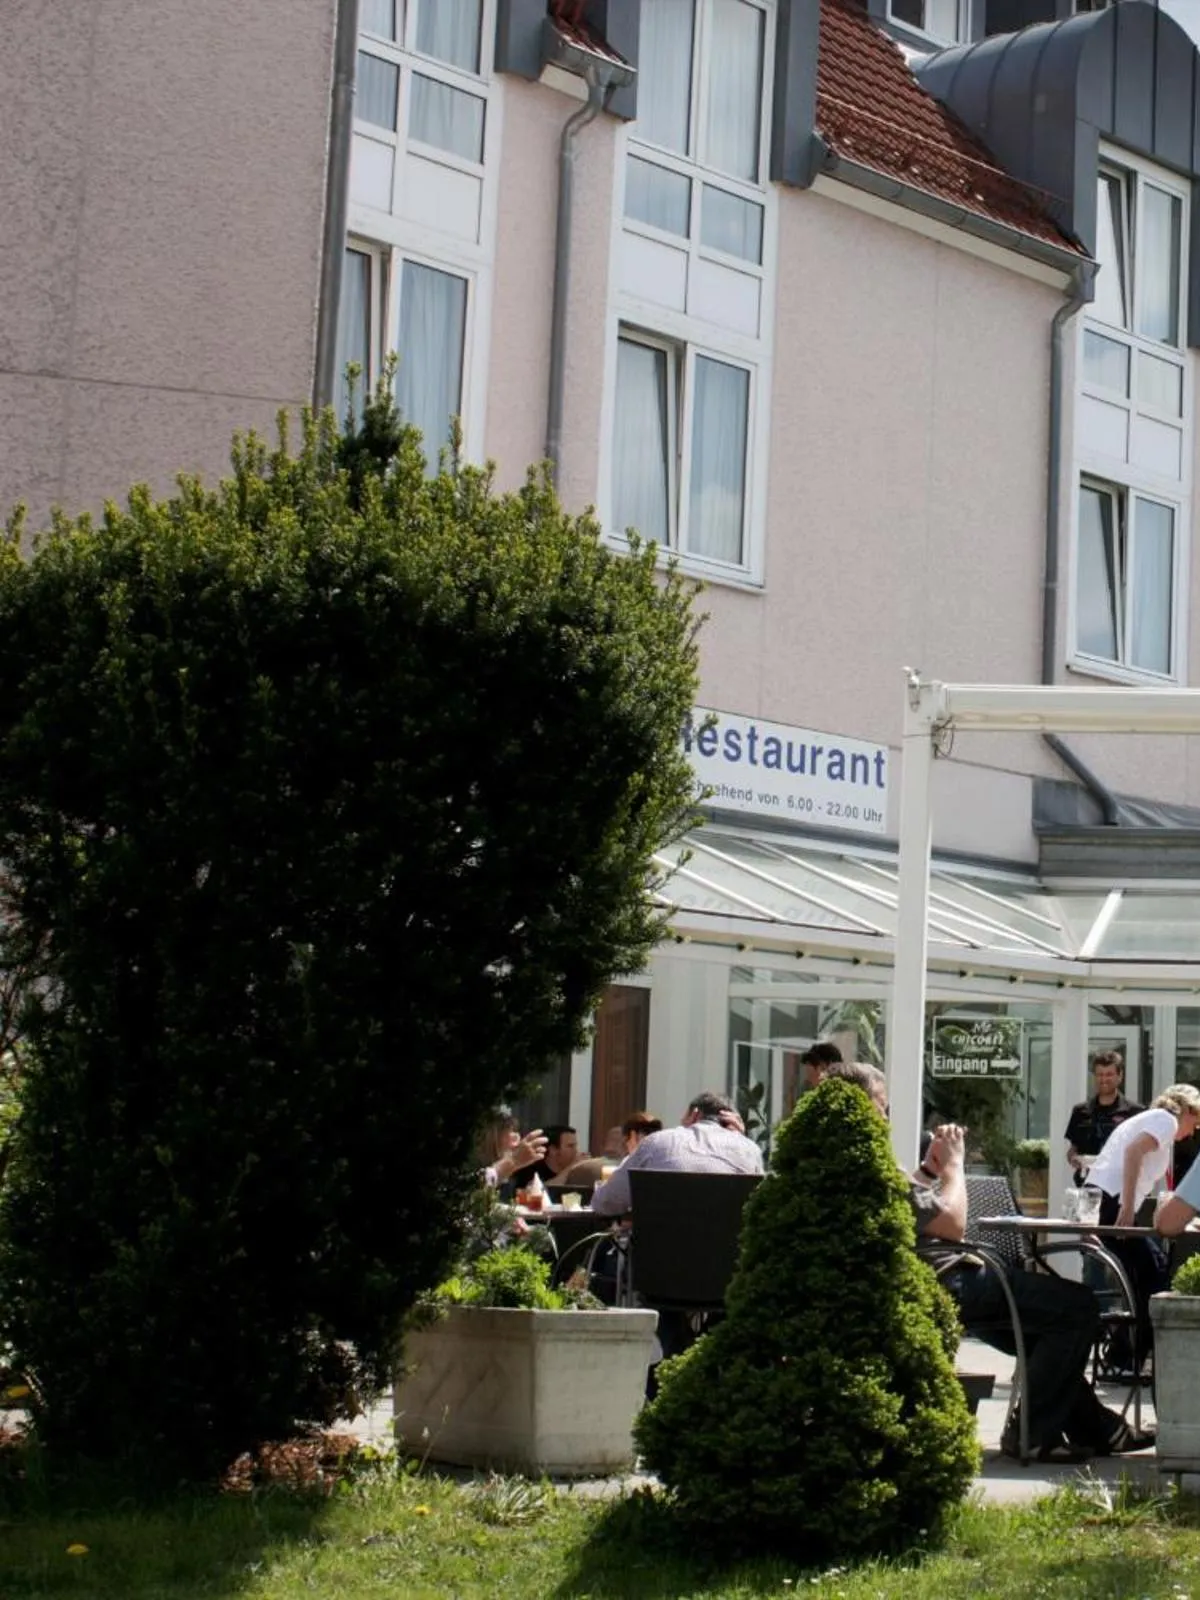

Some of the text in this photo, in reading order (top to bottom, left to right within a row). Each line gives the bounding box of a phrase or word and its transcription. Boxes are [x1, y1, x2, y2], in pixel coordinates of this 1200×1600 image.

[757, 793, 780, 806] von
[787, 795, 814, 812] 6.00
[826, 801, 859, 819] 22.00
[863, 807, 882, 822] Uhr
[935, 1055, 988, 1074] Eingang
